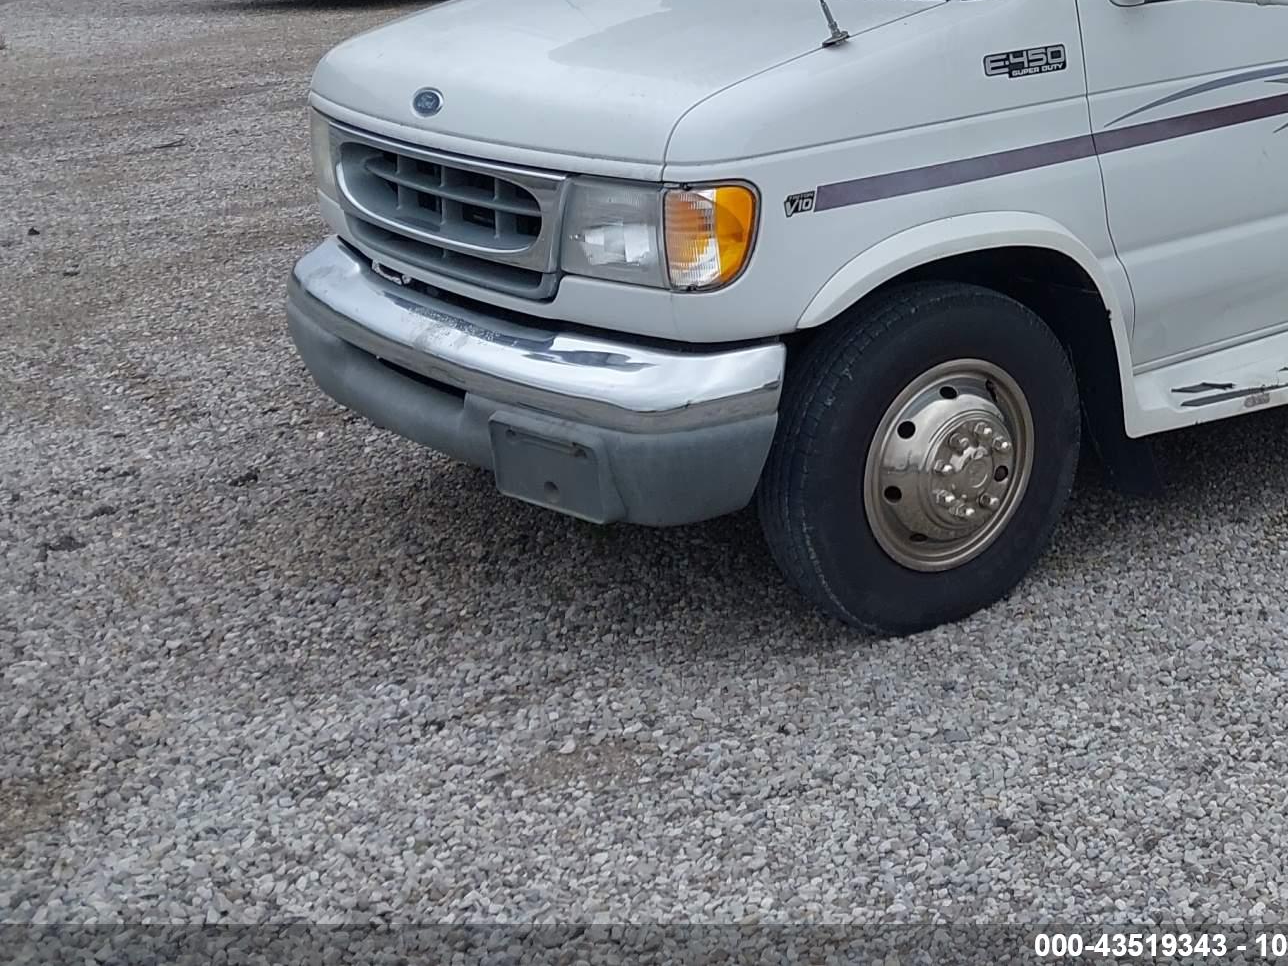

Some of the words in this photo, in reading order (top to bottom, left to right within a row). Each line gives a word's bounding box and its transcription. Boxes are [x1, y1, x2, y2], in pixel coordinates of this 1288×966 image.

[1011, 67, 1040, 76] SUPER
[1041, 63, 1064, 72] DUTY
[785, 198, 812, 216] V10
